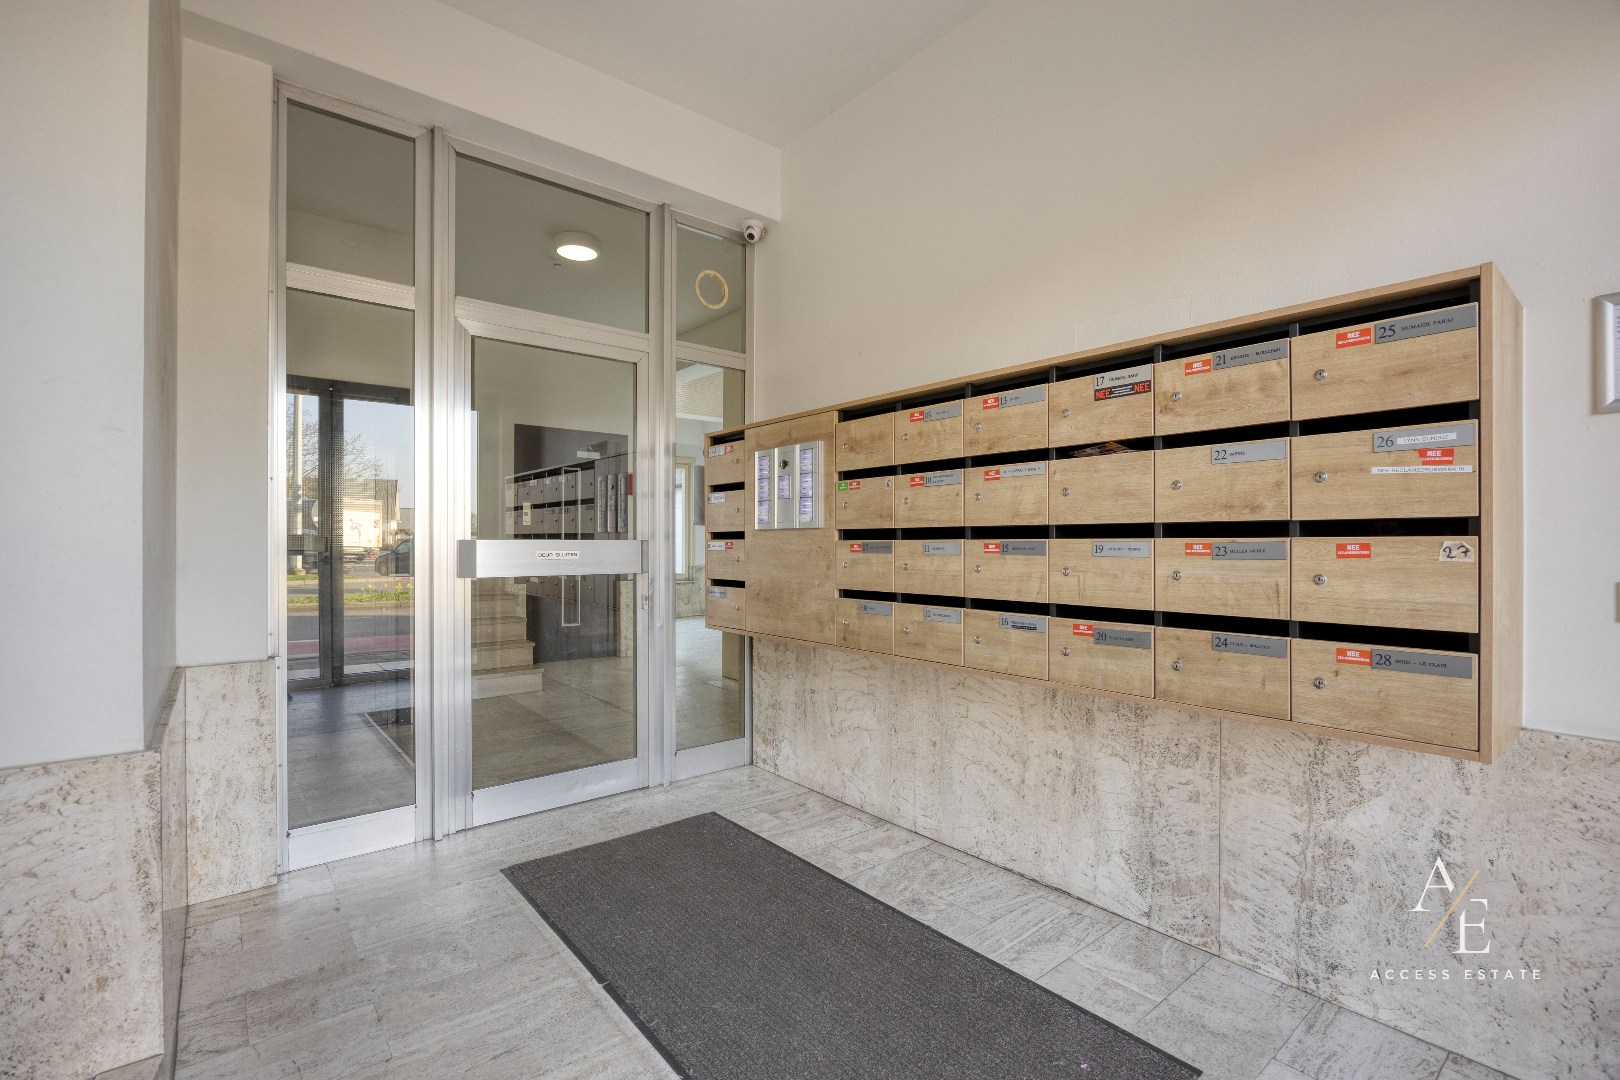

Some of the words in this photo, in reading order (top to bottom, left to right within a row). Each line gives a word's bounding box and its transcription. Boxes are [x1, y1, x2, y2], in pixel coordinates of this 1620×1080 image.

[1378, 325, 1396, 339] 25
[1215, 356, 1226, 366] 21
[1095, 376, 1105, 387] 17
[1134, 381, 1150, 393] NEE
[1095, 389, 1111, 400] NEE
[1000, 396, 1008, 406] 13
[1376, 434, 1394, 448] 26
[1404, 436, 1420, 444] LYNN
[1214, 450, 1227, 460] 22
[1001, 544, 1009, 553] 15
[1094, 544, 1104, 554] 19
[1214, 546, 1227, 557] 23
[1442, 544, 1470, 559] 27
[925, 610, 931, 618] 12
[1001, 617, 1008, 626] 16
[1096, 631, 1107, 641] 20
[1215, 637, 1228, 648] 24
[1375, 653, 1392, 666] 28
